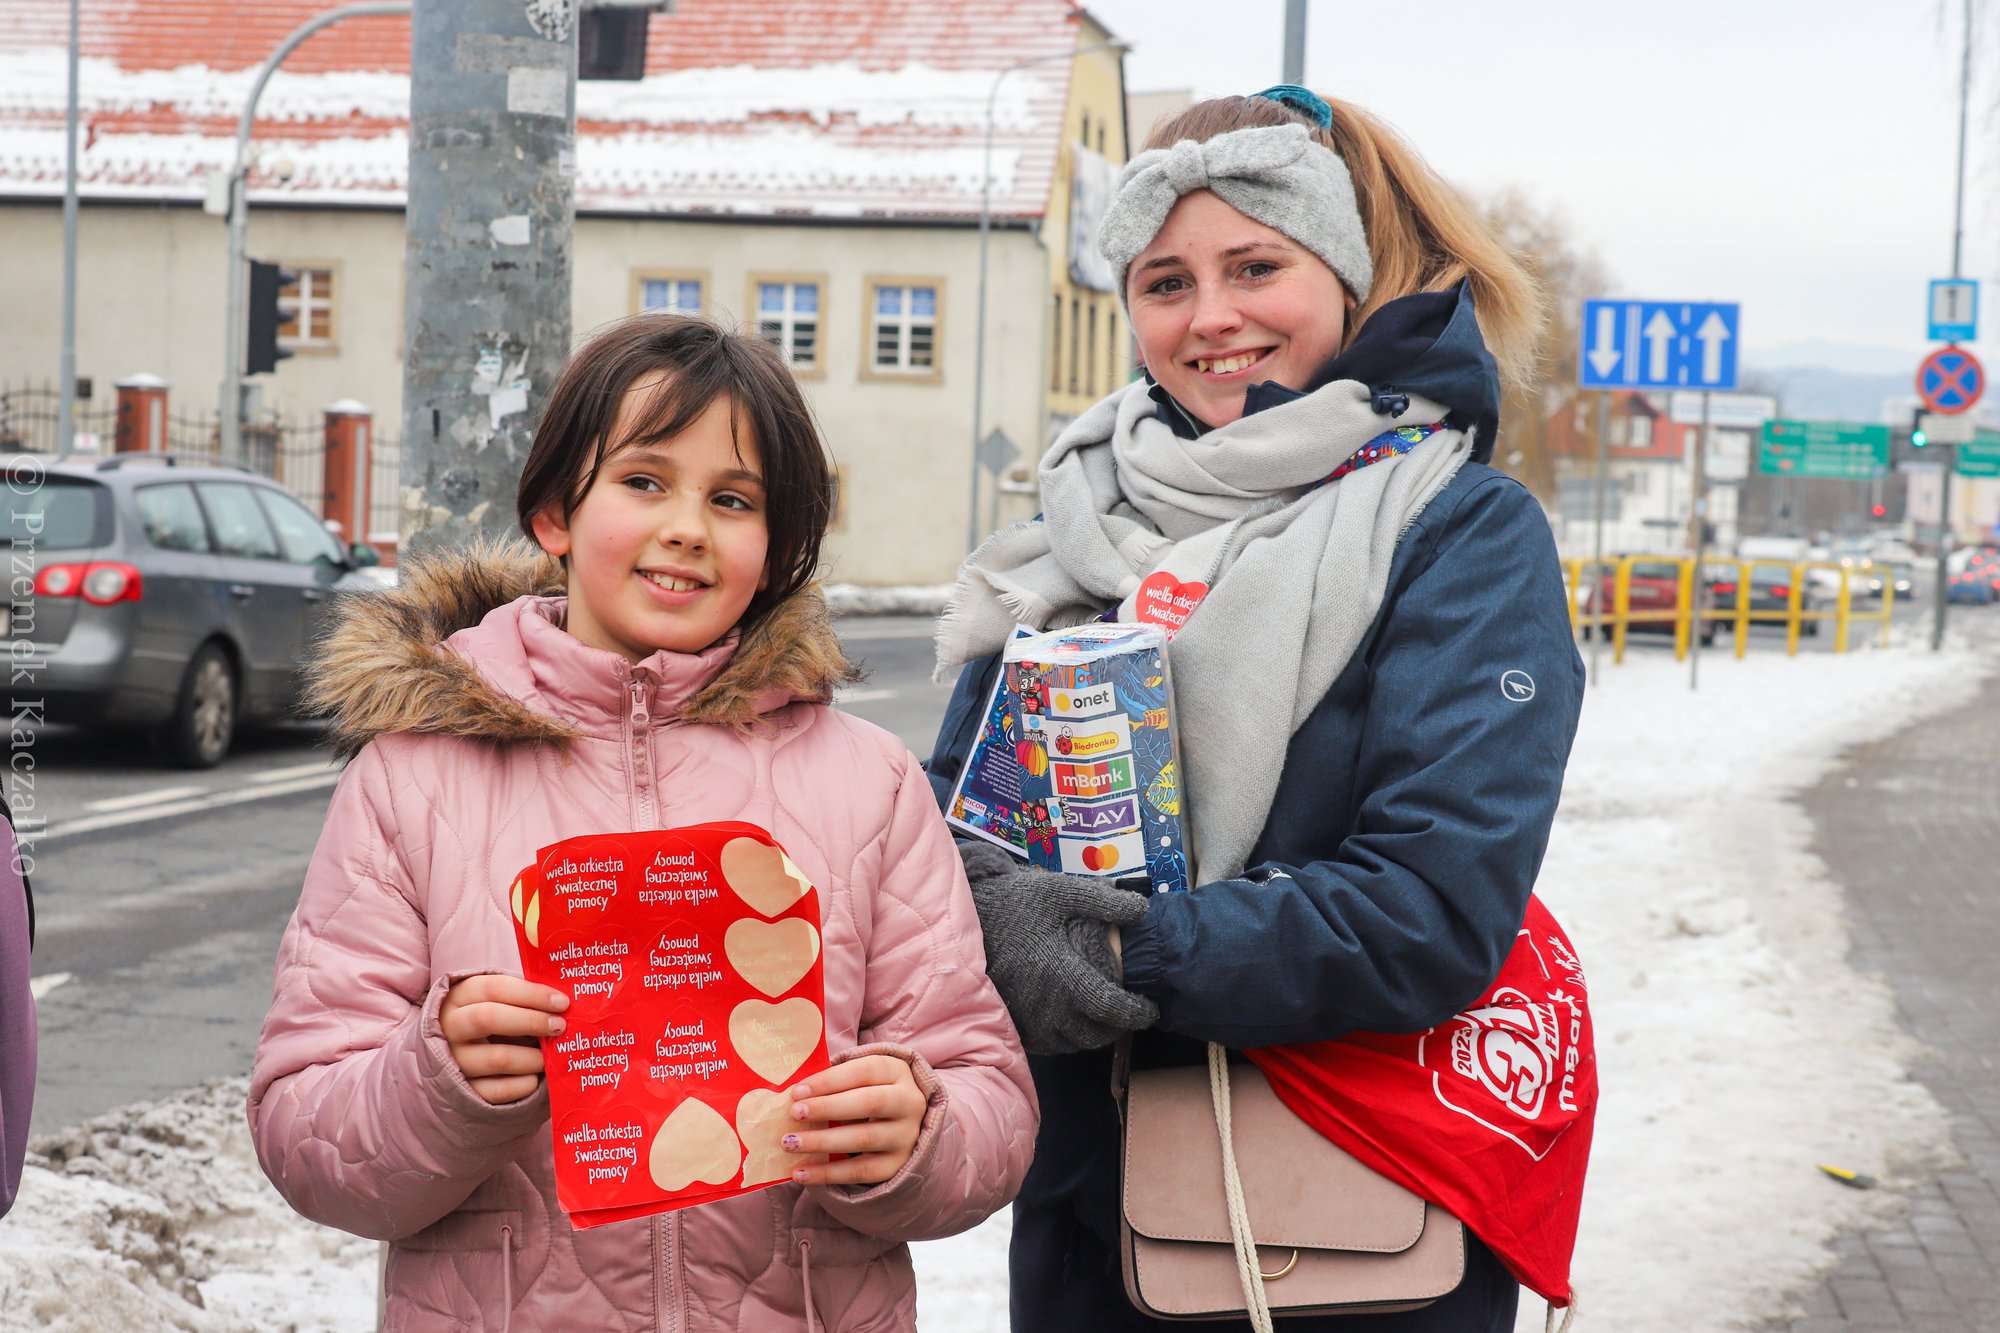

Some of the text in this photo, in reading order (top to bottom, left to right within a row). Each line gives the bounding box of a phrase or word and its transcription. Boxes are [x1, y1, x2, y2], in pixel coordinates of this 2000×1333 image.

[1146, 585, 1173, 603] wielka
[1021, 676, 1035, 691] 31
[1073, 690, 1110, 708] onet
[1073, 738, 1116, 751] Biedronka
[1062, 768, 1124, 788] mBank
[964, 797, 987, 811] RICOH
[546, 856, 623, 878] wielka orkiestra
[654, 852, 695, 867] pomocy
[555, 876, 617, 896] świątecznej
[645, 867, 708, 887] świątecznej
[568, 896, 608, 913] pomocy
[639, 888, 719, 905] wielka orkiestra
[550, 940, 628, 962] wielka orkiestra
[659, 934, 699, 950] pomocy
[560, 958, 623, 981] świątecznej
[650, 950, 712, 971] świątecznej
[644, 972, 687, 990] orkiestra
[689, 971, 722, 989] wielka
[574, 981, 614, 1000] pomocy
[663, 1020, 704, 1038] pomocy
[557, 1029, 634, 1053] wielka orkiestra
[656, 1039, 717, 1059] świątecznej
[568, 1049, 629, 1072] świątecznej
[650, 1059, 728, 1081] wielka orkiestra
[581, 1072, 620, 1091] pomocy
[563, 1121, 642, 1144] wielka orkiestra
[576, 1142, 636, 1165] świątecznej
[589, 1165, 628, 1184] pomocy
